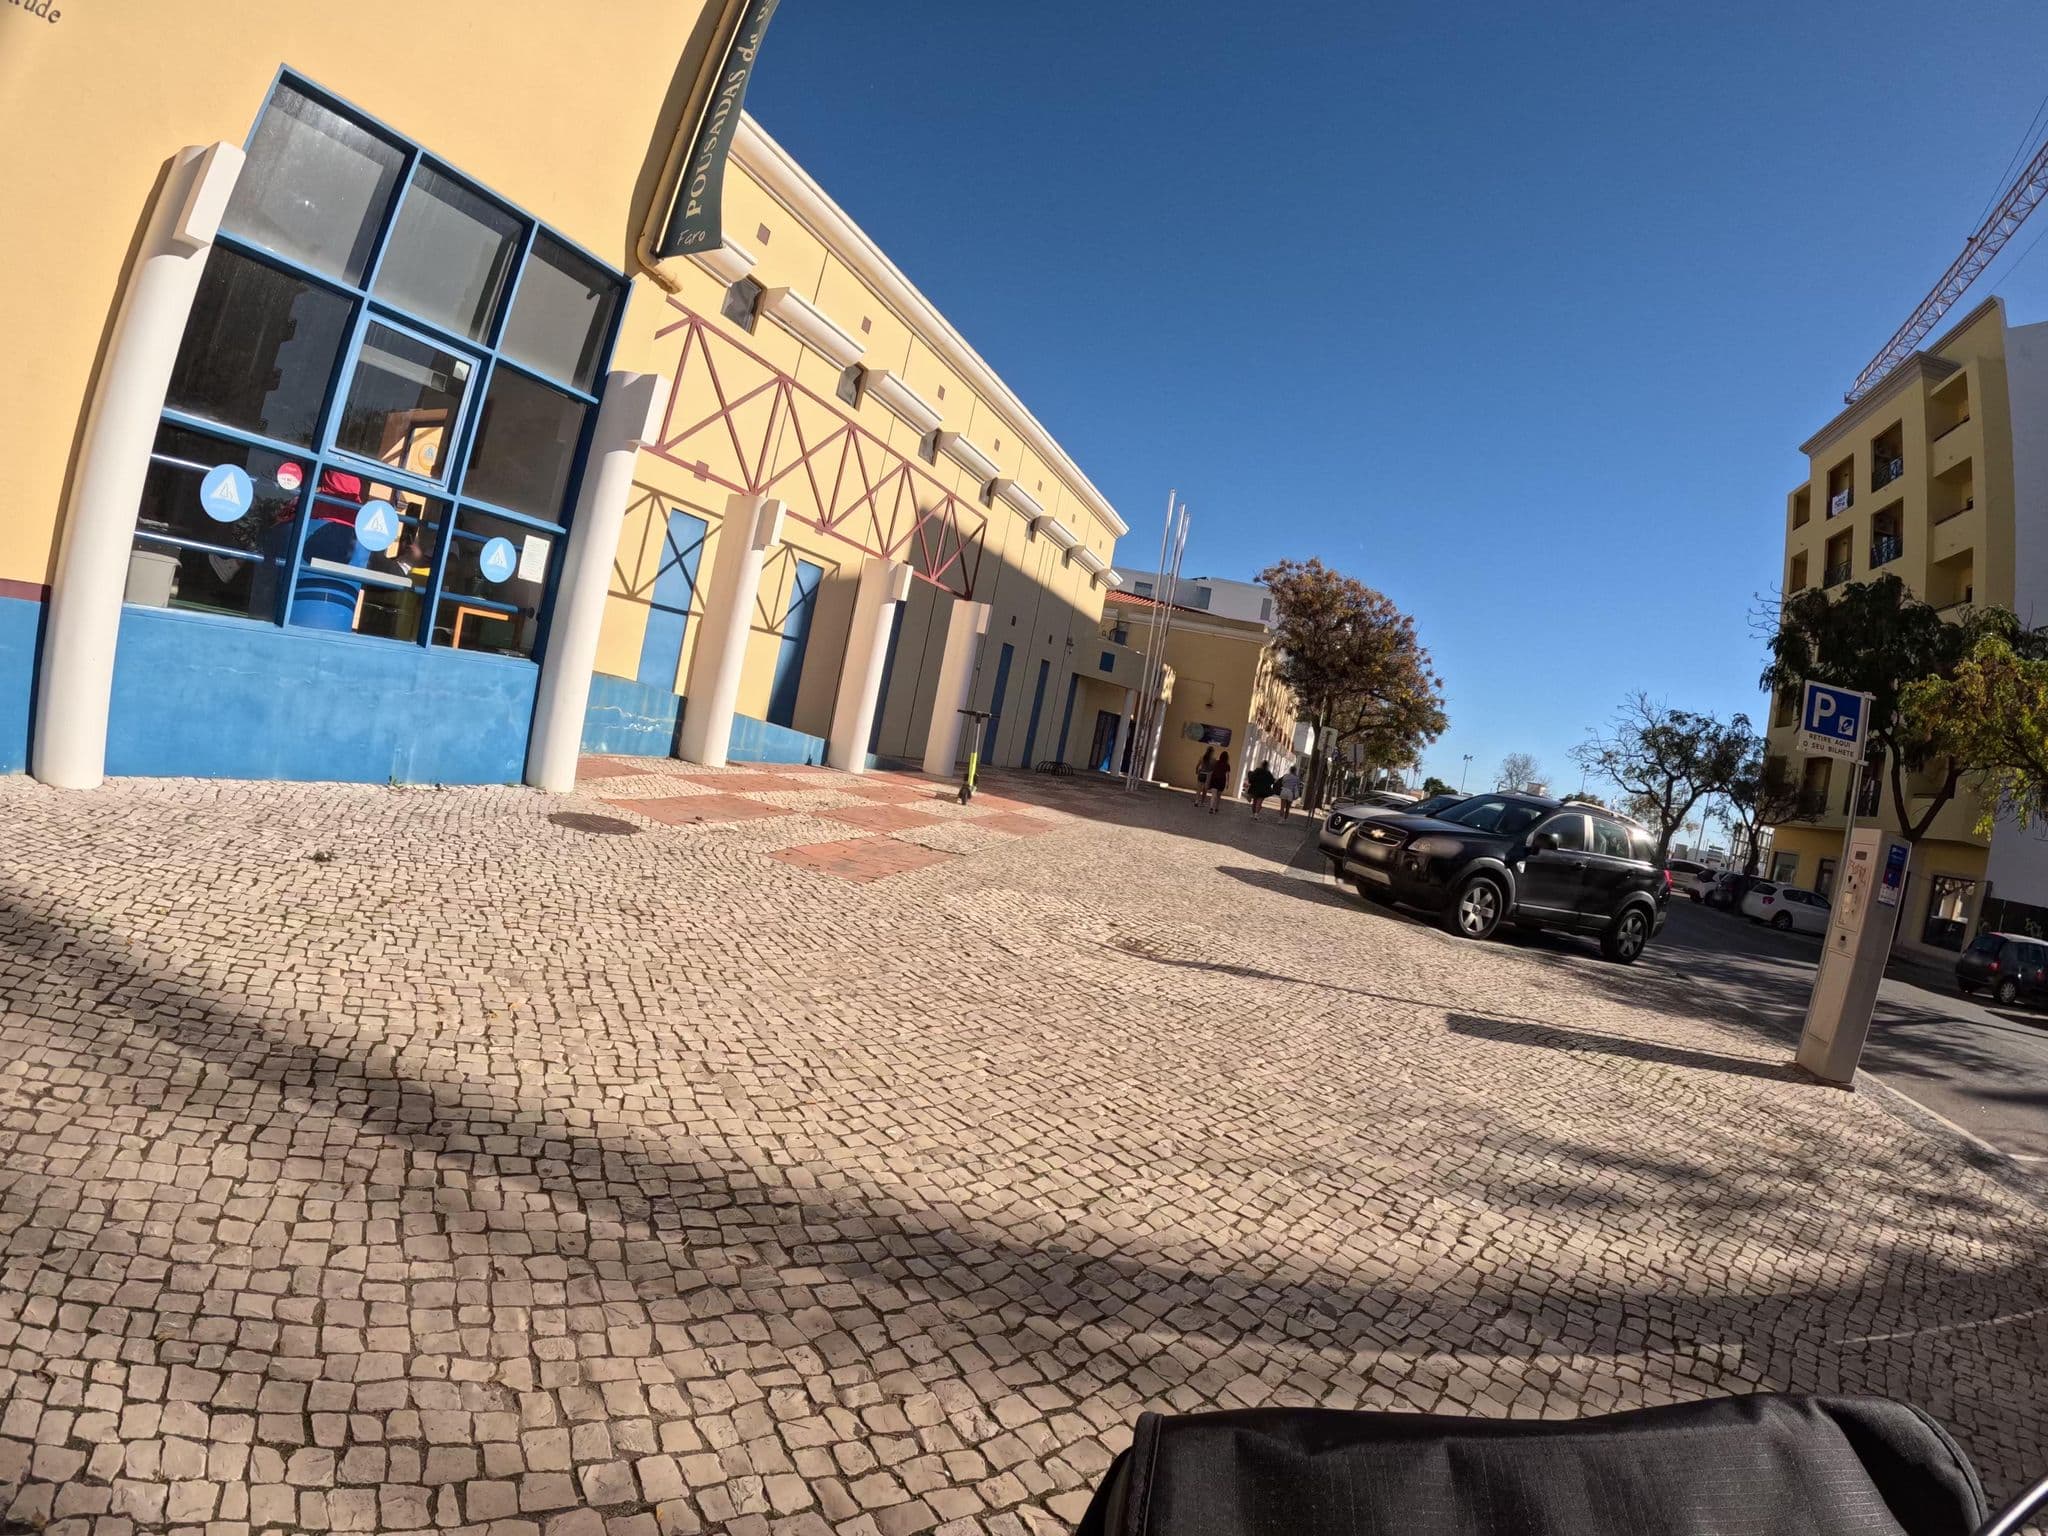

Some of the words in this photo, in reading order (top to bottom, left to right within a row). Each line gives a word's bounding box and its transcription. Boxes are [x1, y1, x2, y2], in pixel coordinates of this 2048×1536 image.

[685, 69, 746, 219] POUSADAS
[677, 229, 706, 246] Faro
[1812, 692, 1836, 728] P
[1808, 733, 1831, 744] RETIRE
[1834, 739, 1851, 748] AQUI
[1812, 742, 1825, 751] SEU
[1828, 746, 1854, 758] BILHETE
